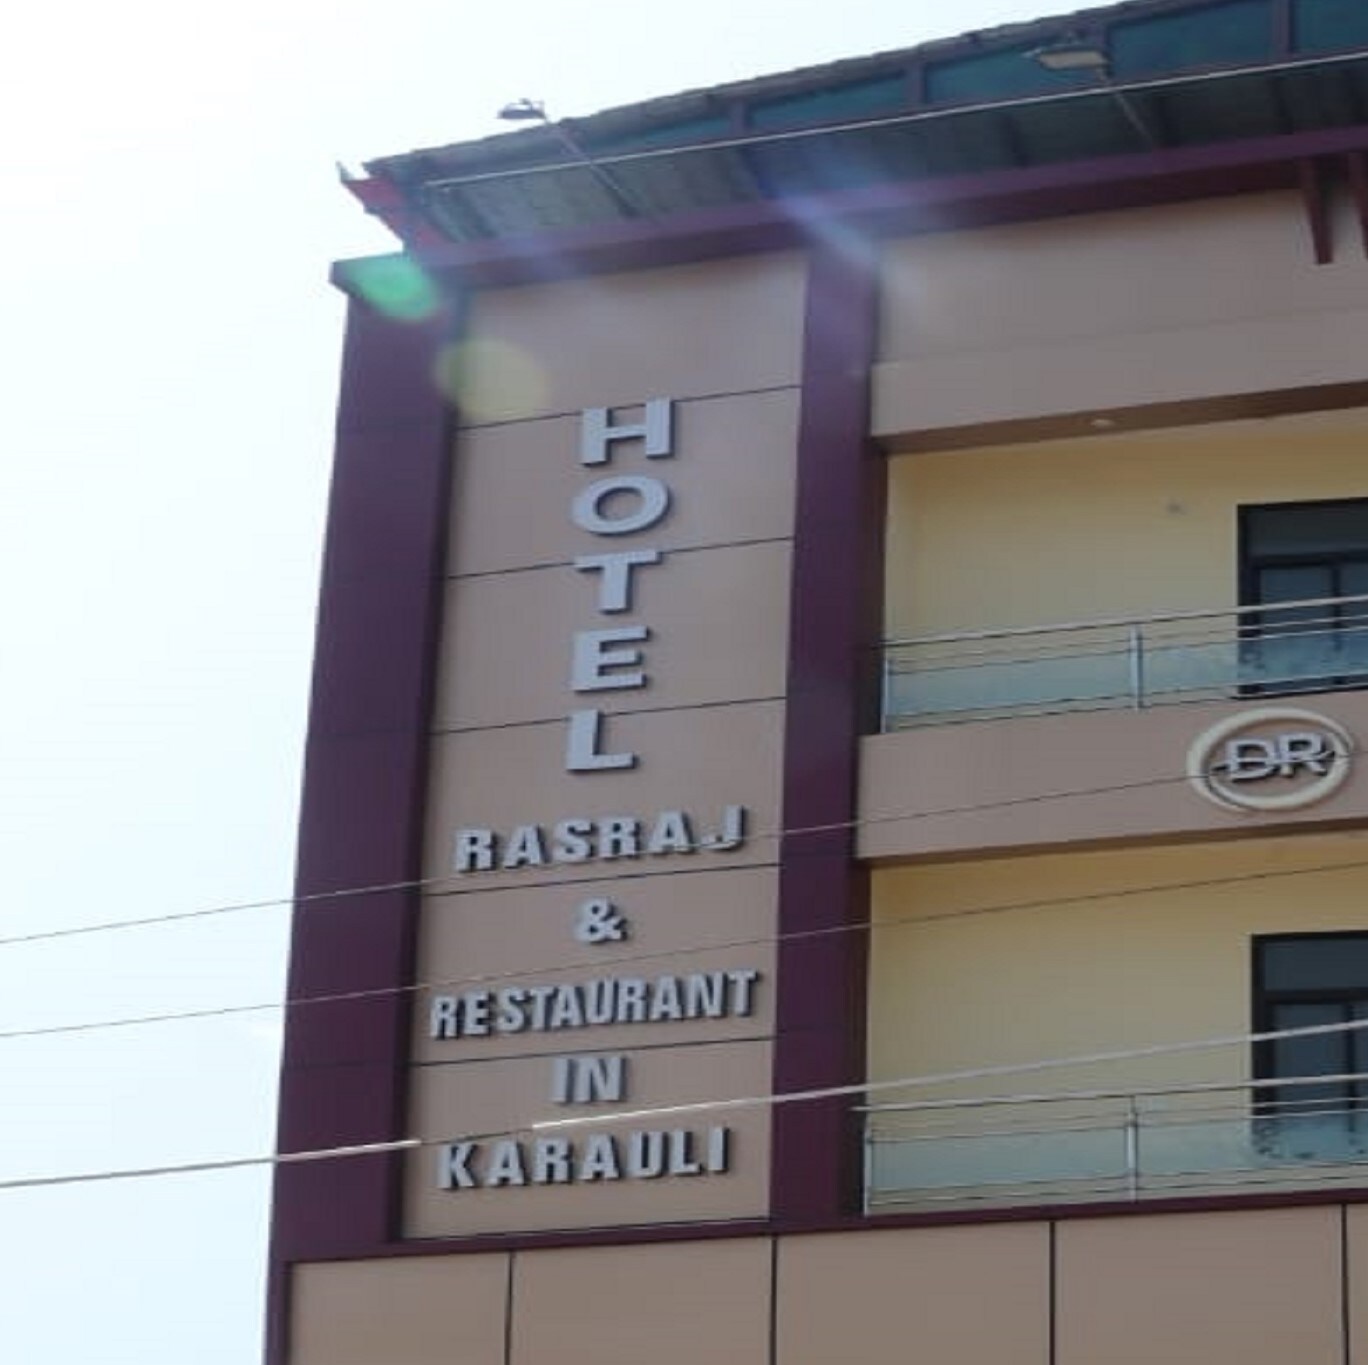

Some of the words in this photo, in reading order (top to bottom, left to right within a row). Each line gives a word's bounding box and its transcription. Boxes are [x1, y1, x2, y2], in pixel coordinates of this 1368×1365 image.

[566, 396, 675, 775] HOTEL
[453, 804, 748, 874] RASRAJ
[572, 897, 628, 945] &
[428, 968, 762, 1040] RESTAURANT
[552, 1055, 628, 1106] IN
[435, 1126, 732, 1191] KARAULI
